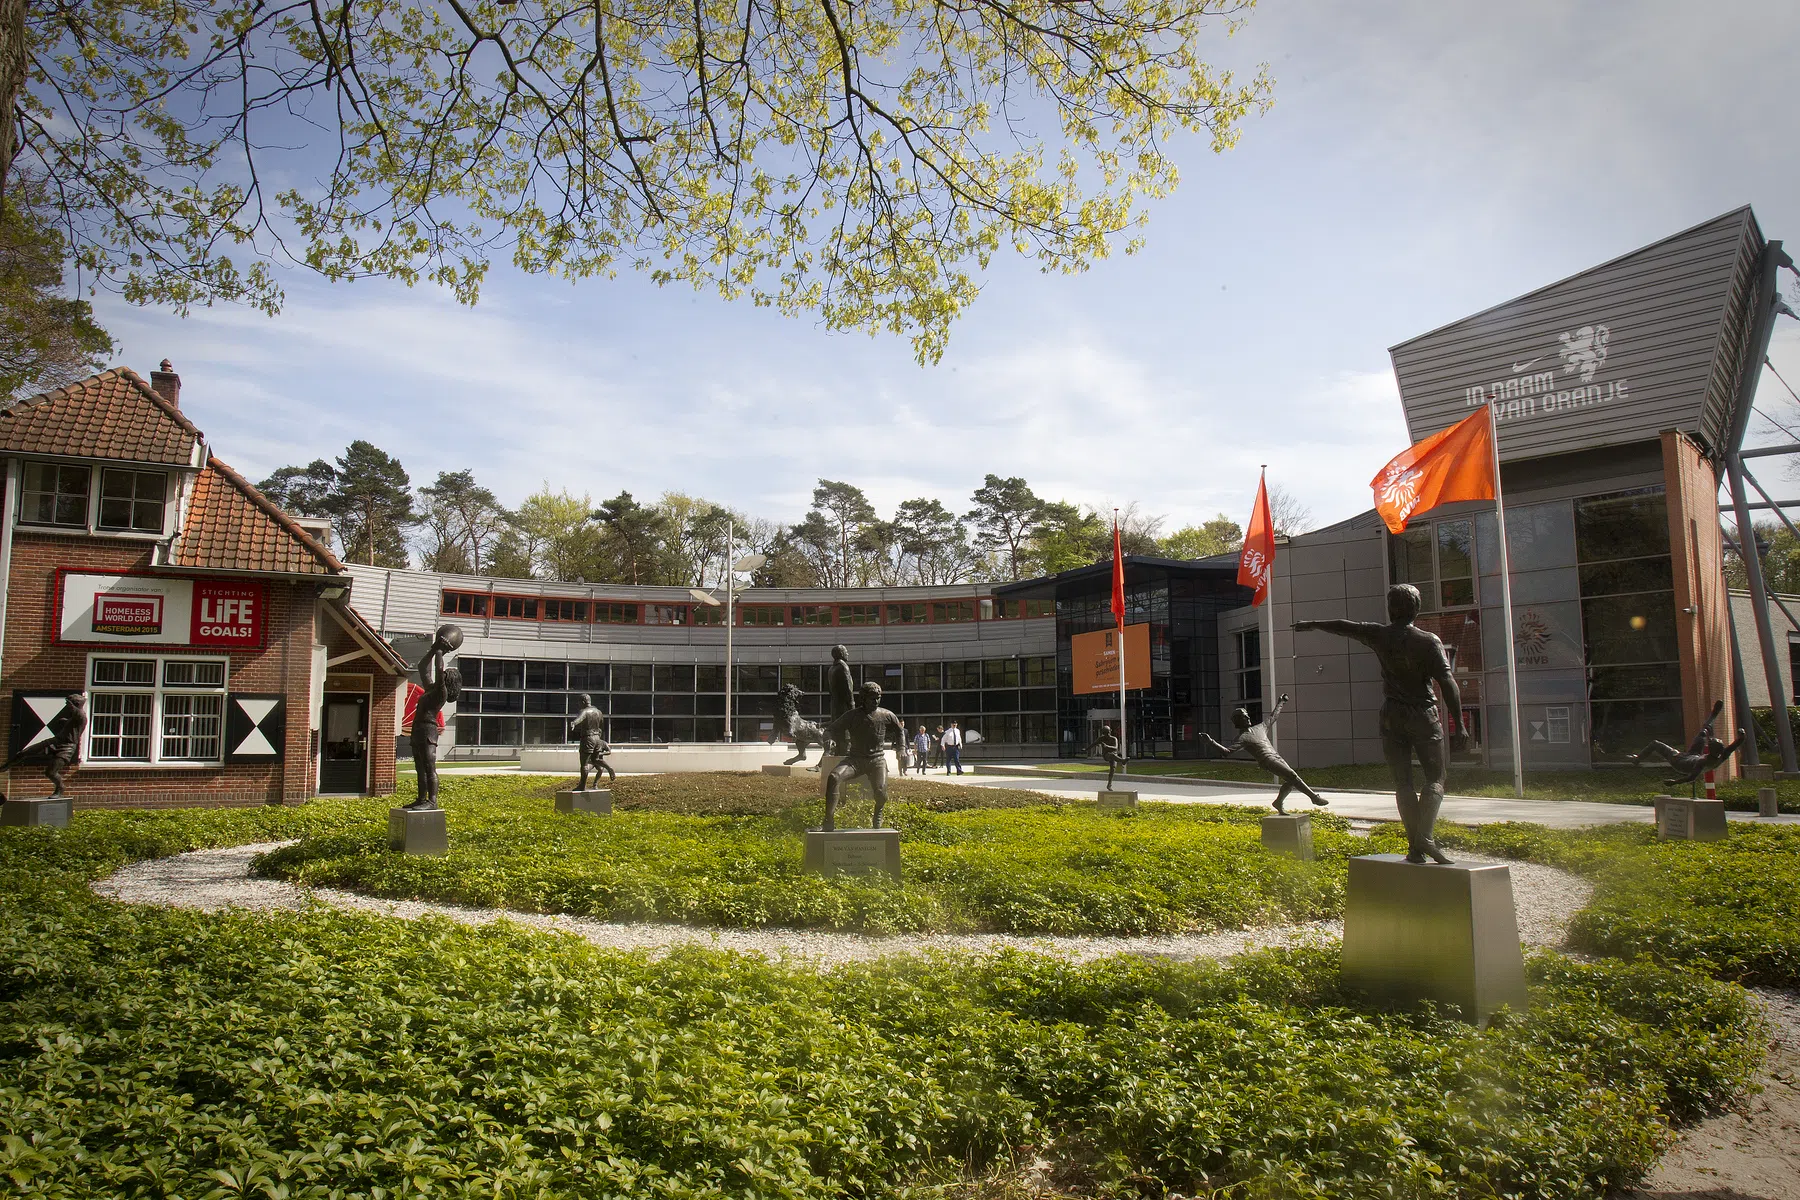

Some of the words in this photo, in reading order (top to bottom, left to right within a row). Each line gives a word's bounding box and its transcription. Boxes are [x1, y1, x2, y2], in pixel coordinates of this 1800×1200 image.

[1466, 385, 1485, 406] IN
[1491, 371, 1555, 399] NAAM
[1494, 397, 1536, 421] VAN
[1542, 379, 1629, 413] ORANJE
[116, 585, 149, 593] organisator
[202, 589, 254, 597] STICHTING
[105, 607, 151, 616] HOMELESS
[104, 614, 133, 622] WORLD
[134, 615, 151, 623] CUP
[96, 625, 140, 633] AMSTERDAM
[200, 625, 252, 638] GOALS!
[1518, 655, 1549, 665] KNVB
